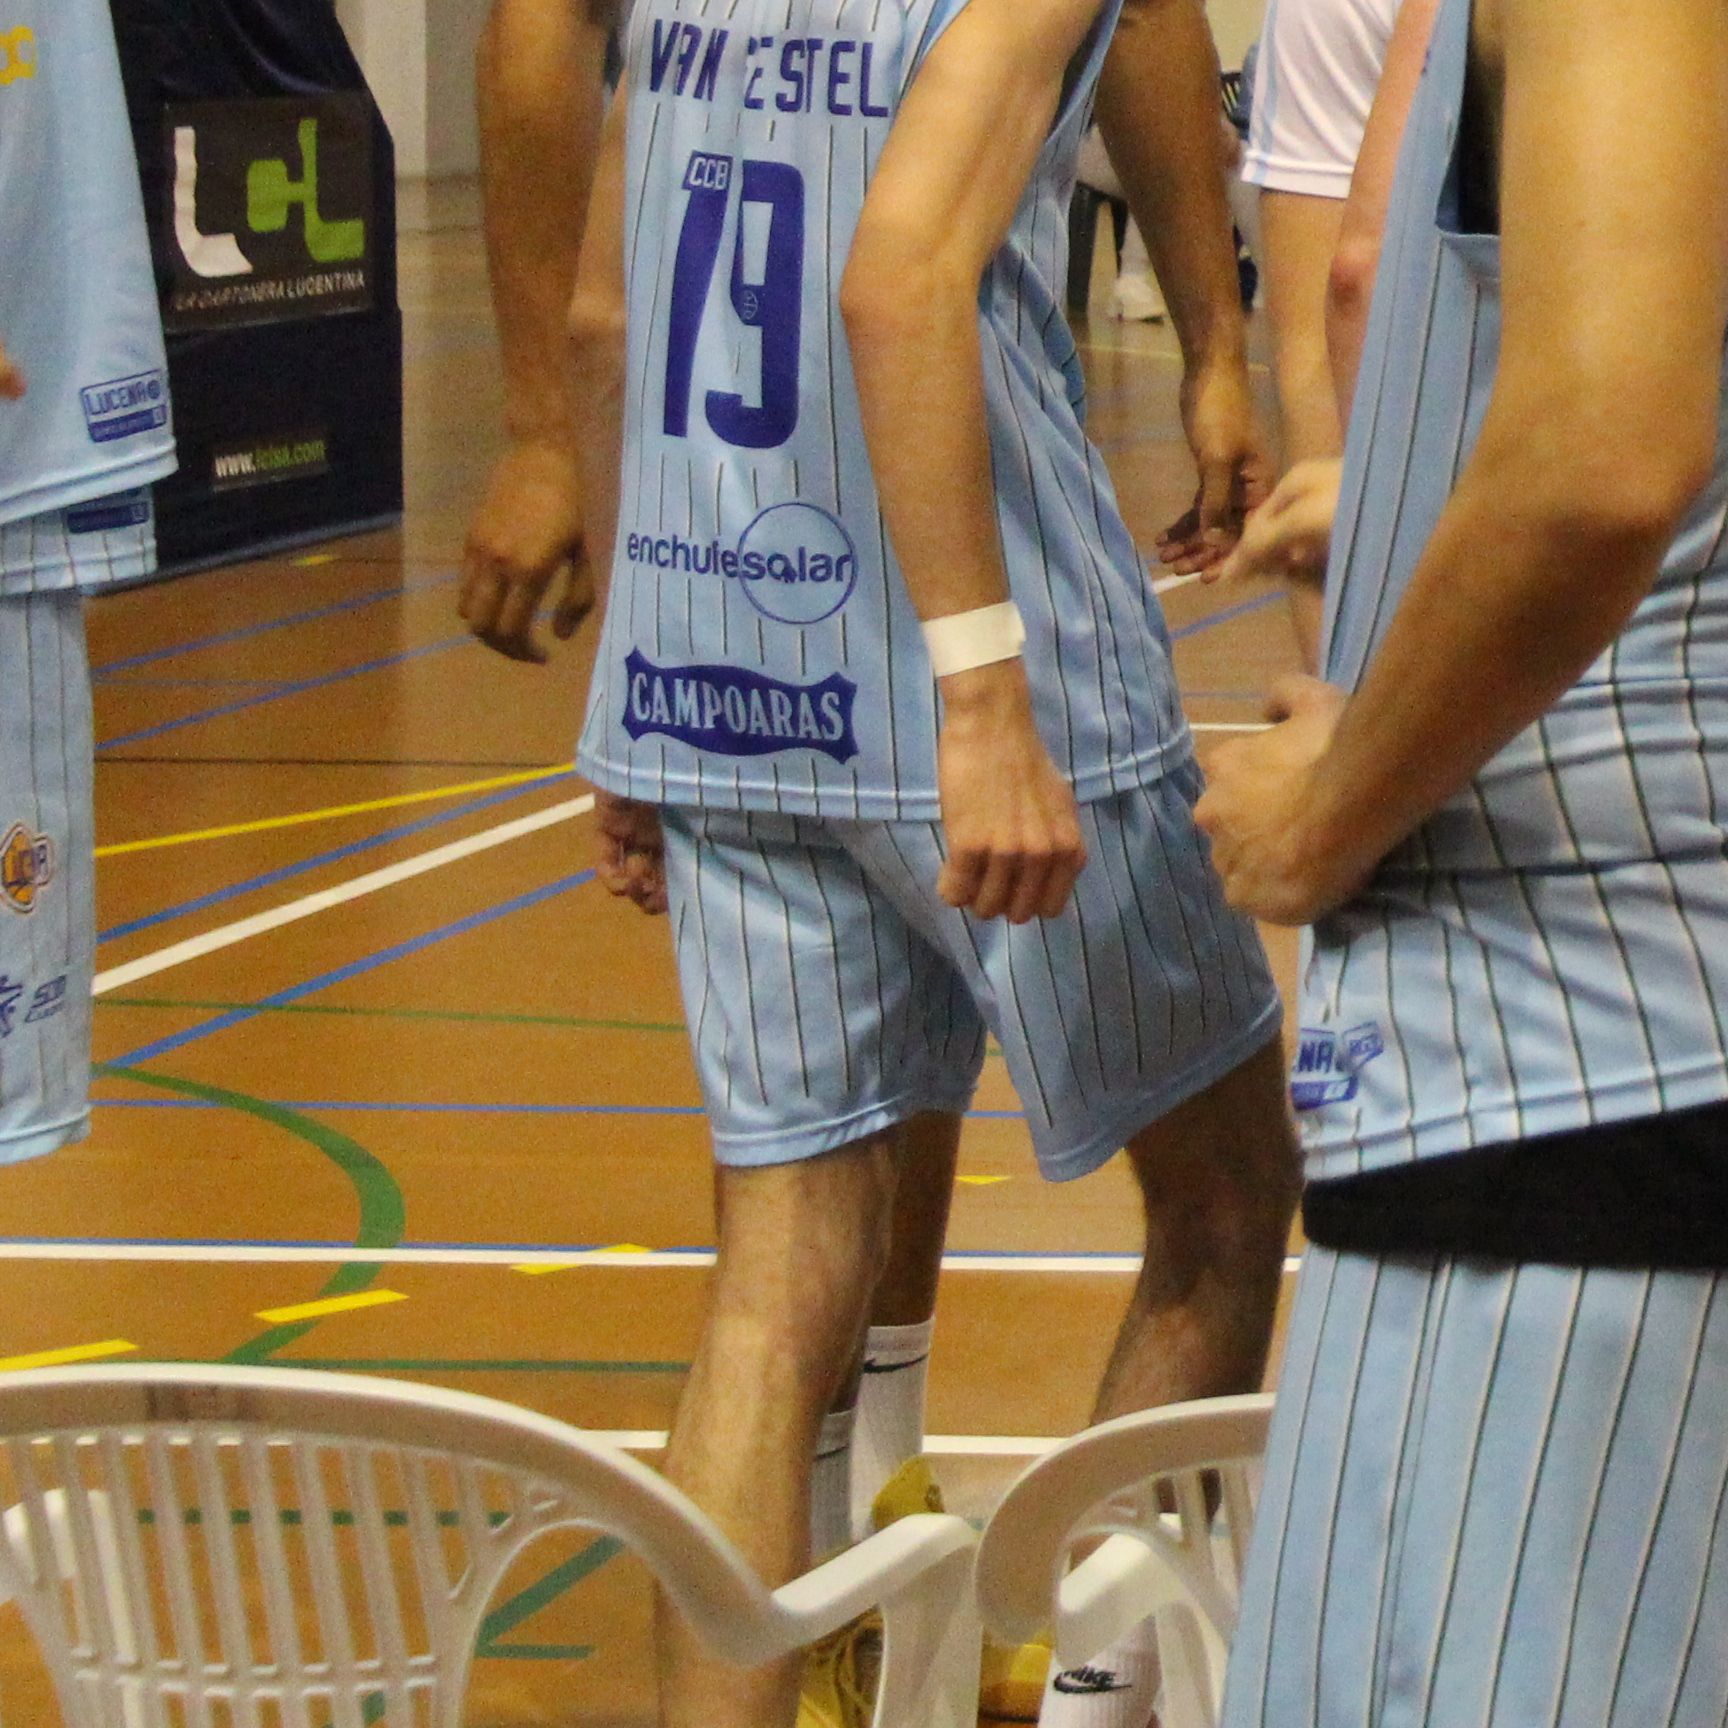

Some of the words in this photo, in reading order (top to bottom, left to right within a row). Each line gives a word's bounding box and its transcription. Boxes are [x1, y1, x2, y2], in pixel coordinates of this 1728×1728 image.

[650, 19, 729, 102] VAN
[690, 156, 729, 190] CCB
[663, 150, 805, 449] 19
[632, 672, 844, 742] CAMPOARAS
